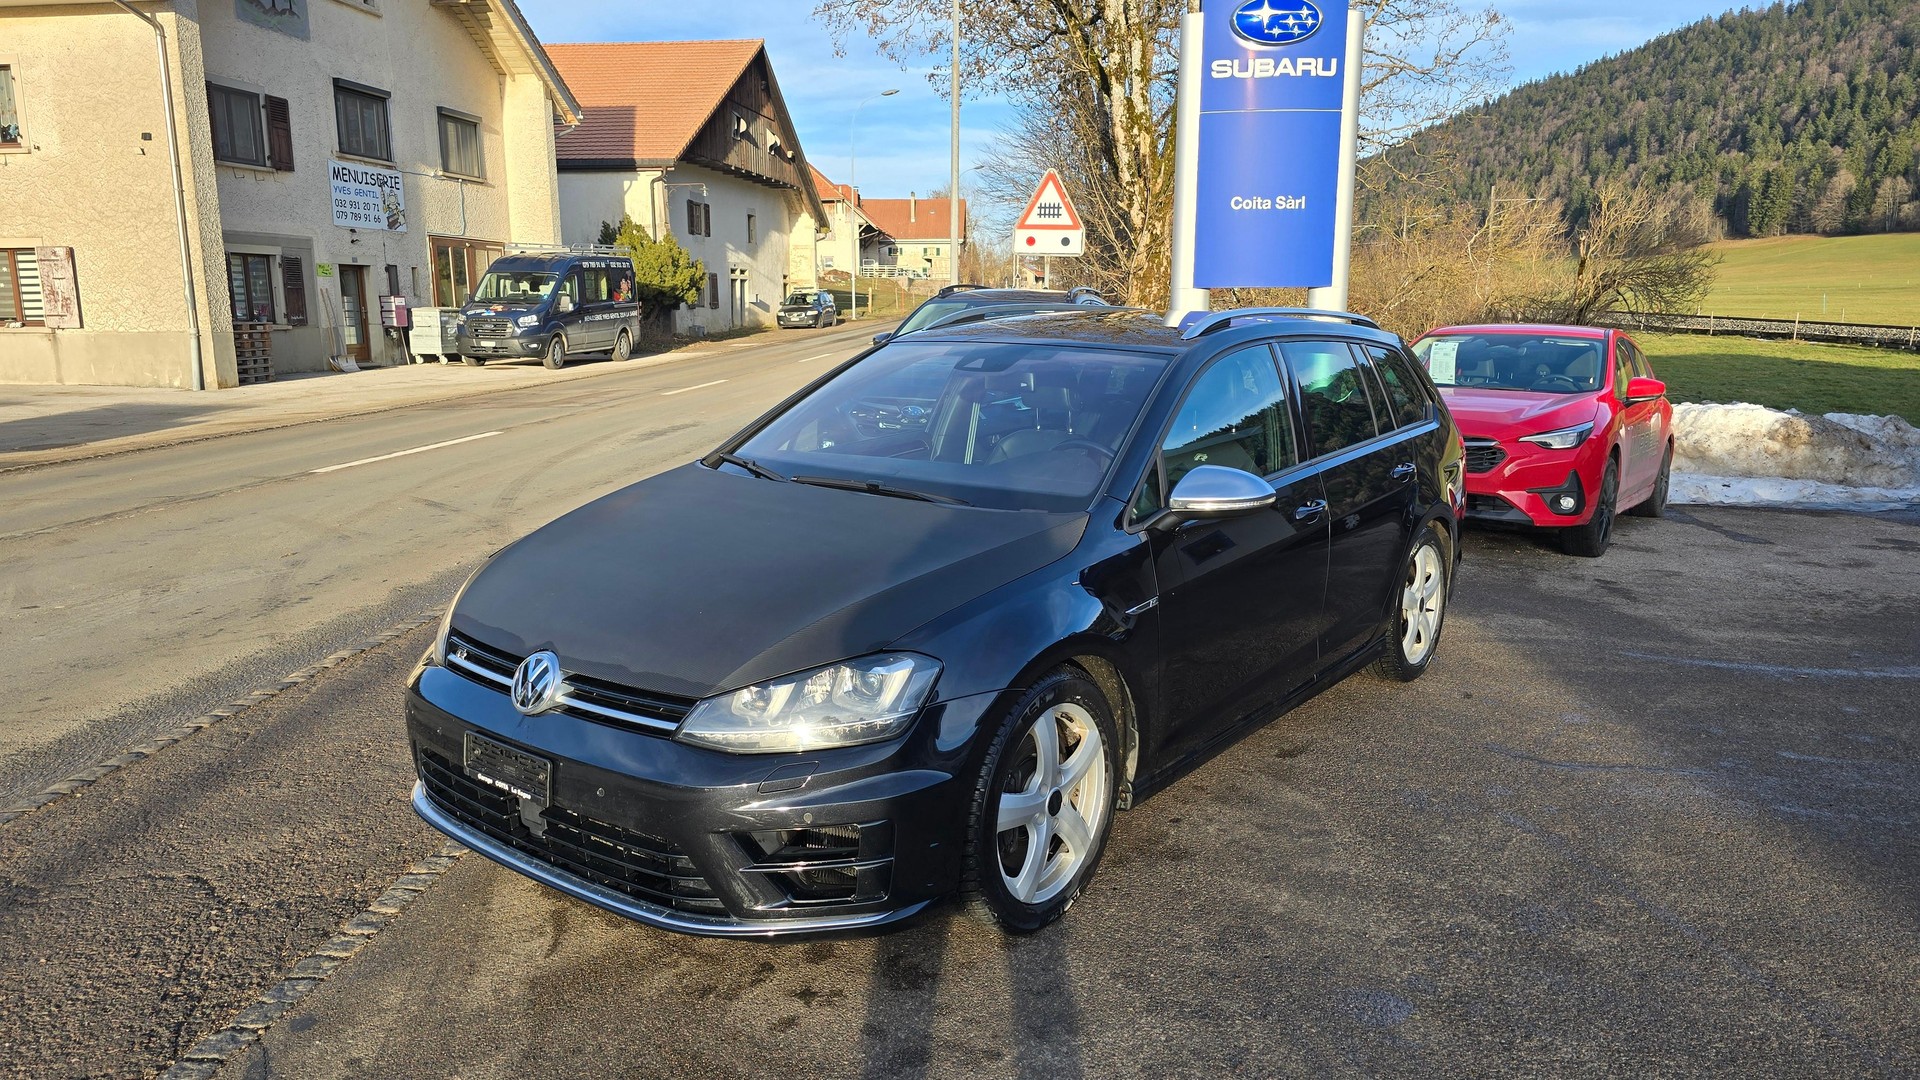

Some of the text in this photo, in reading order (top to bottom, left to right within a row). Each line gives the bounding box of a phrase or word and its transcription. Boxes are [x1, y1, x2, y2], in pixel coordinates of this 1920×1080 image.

[1211, 57, 1338, 79] SUBARU
[332, 166, 400, 191] MENUISERIE
[333, 185, 379, 199] YVES GENTIL
[335, 198, 380, 212] 032 931 20 71
[1230, 196, 1272, 210] Coita
[336, 210, 348, 220] 079
[350, 212, 362, 221] 789
[363, 213, 371, 222] 91
